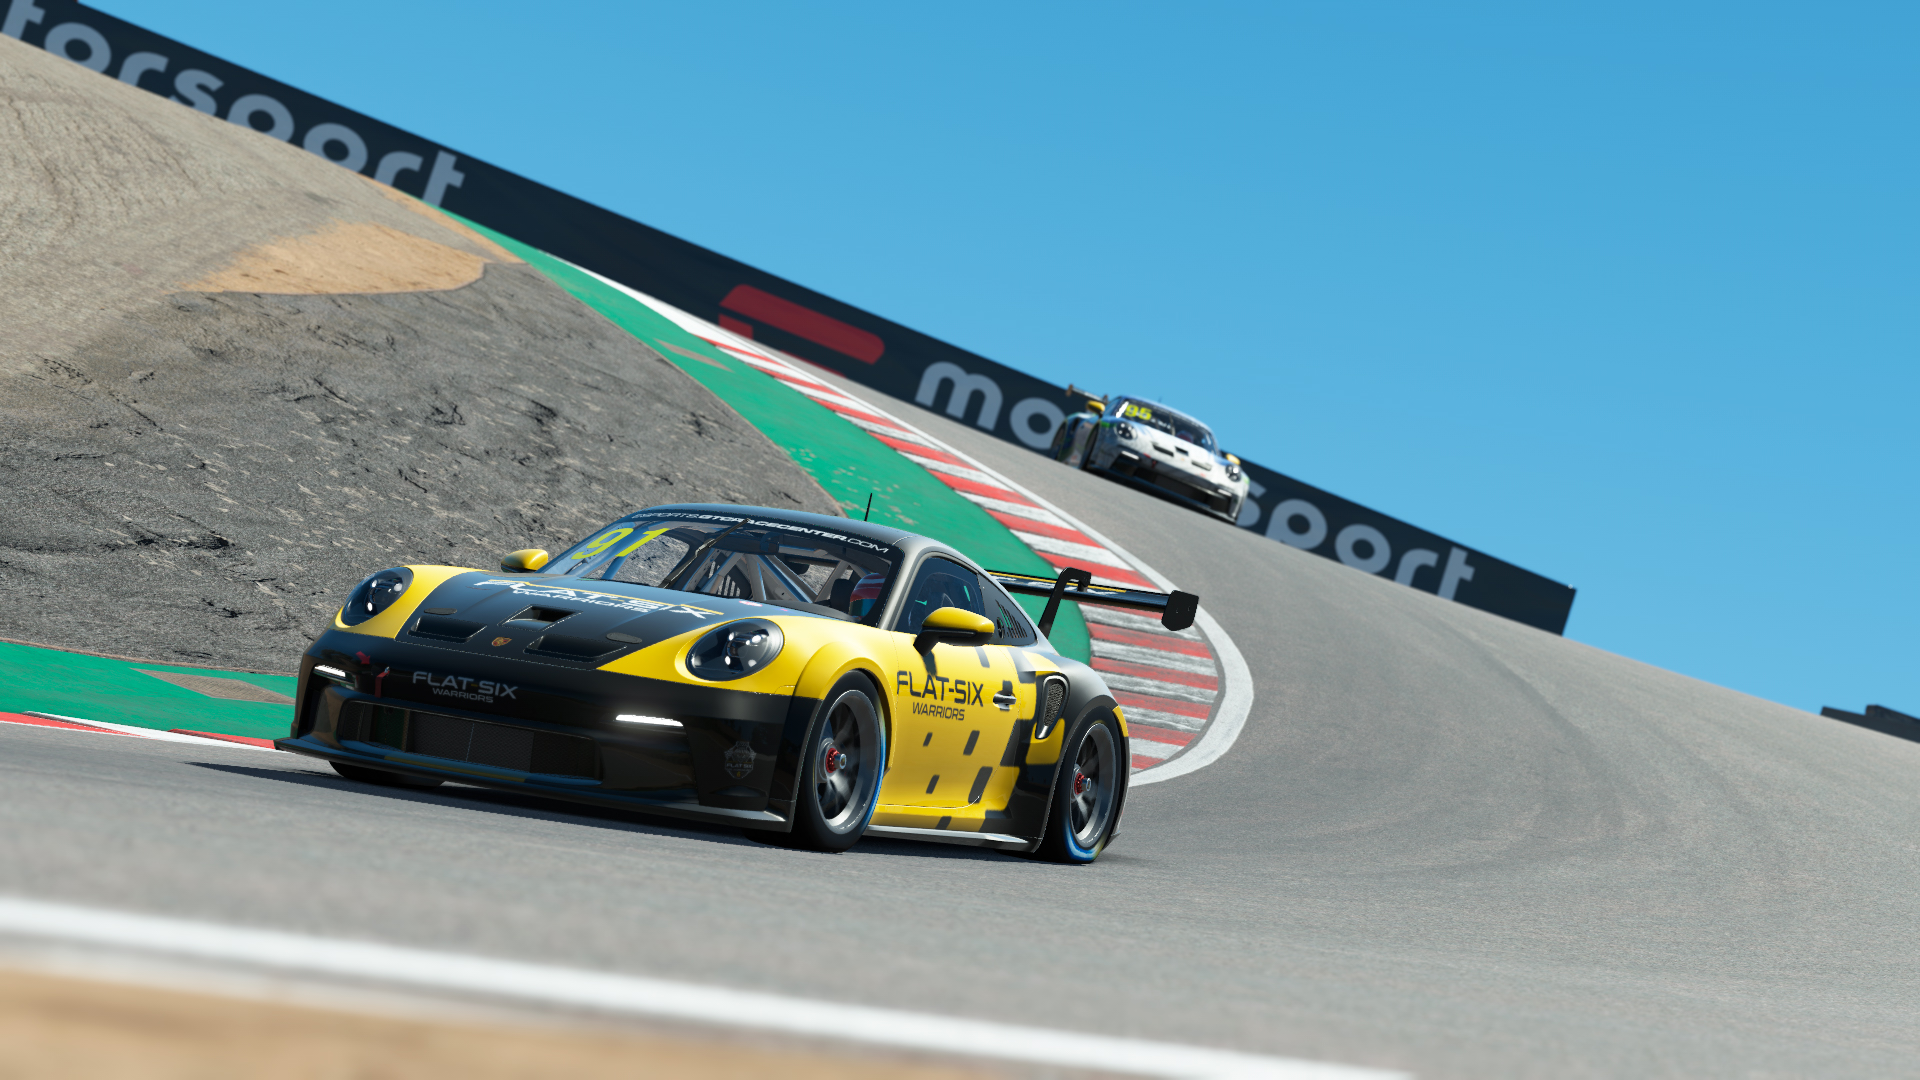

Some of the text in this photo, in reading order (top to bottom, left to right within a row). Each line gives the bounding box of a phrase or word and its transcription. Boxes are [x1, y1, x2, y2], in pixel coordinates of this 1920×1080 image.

[570, 528, 671, 560] 91
[412, 671, 519, 700] FLAT-SIX
[432, 687, 494, 704] WARRIORS
[897, 670, 984, 707] FLAT-SIX
[913, 702, 966, 721] WARRIORS
